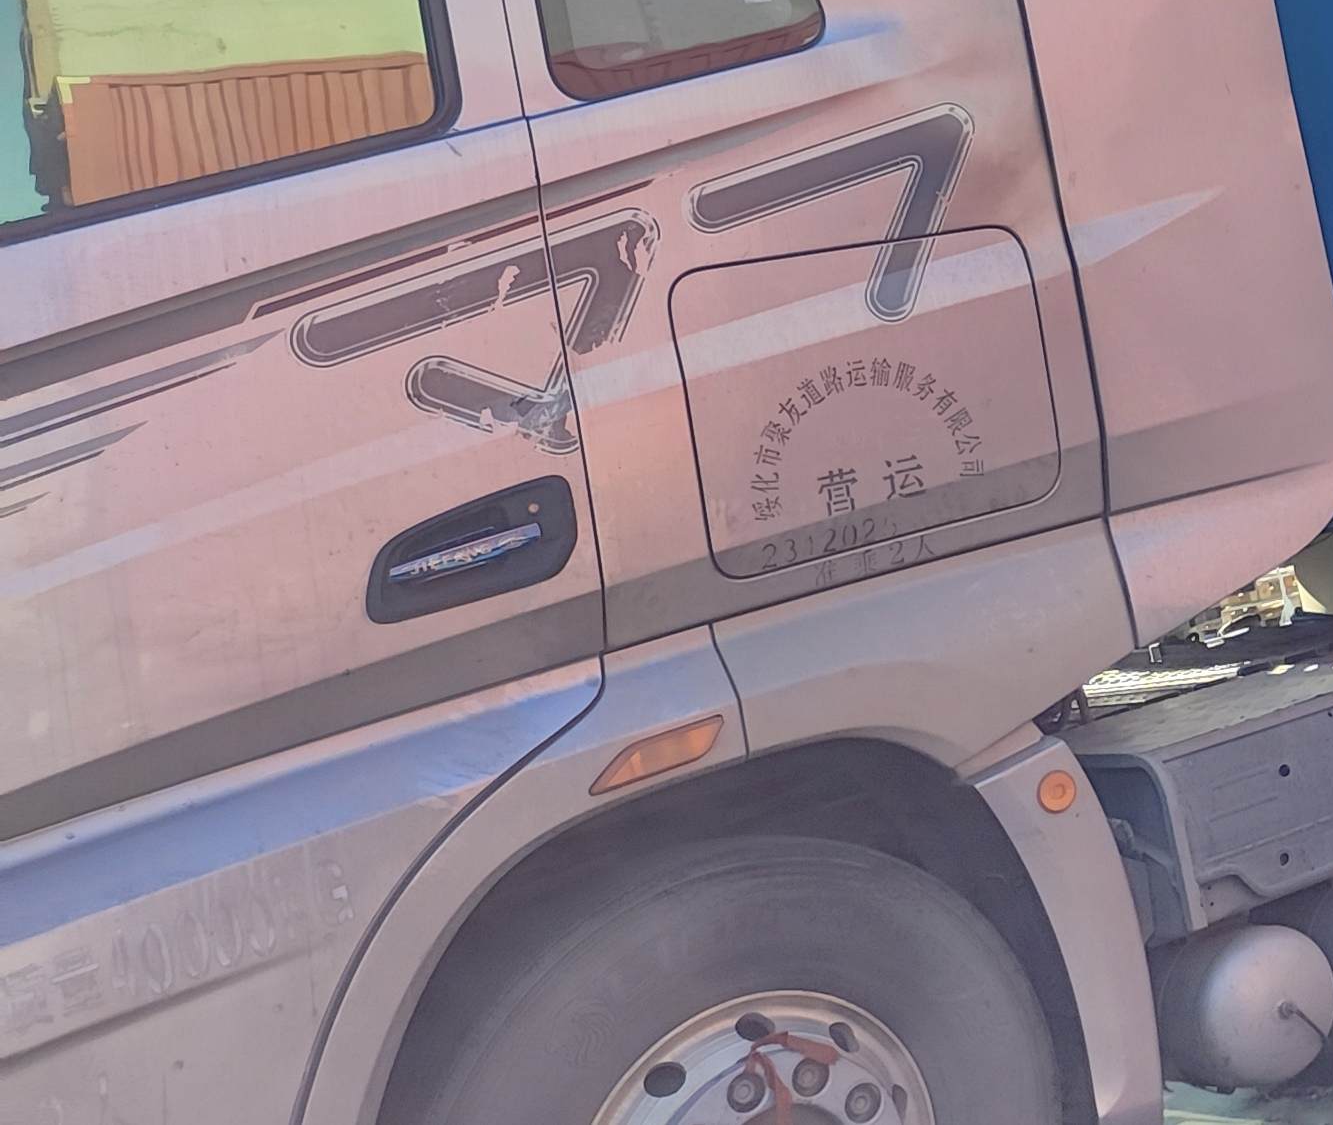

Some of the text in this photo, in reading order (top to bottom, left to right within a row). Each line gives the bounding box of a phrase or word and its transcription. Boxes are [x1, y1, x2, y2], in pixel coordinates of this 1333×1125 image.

[750, 357, 984, 521] 绥化市聚友道路运输服务有限公司
[817, 454, 926, 516] 营运
